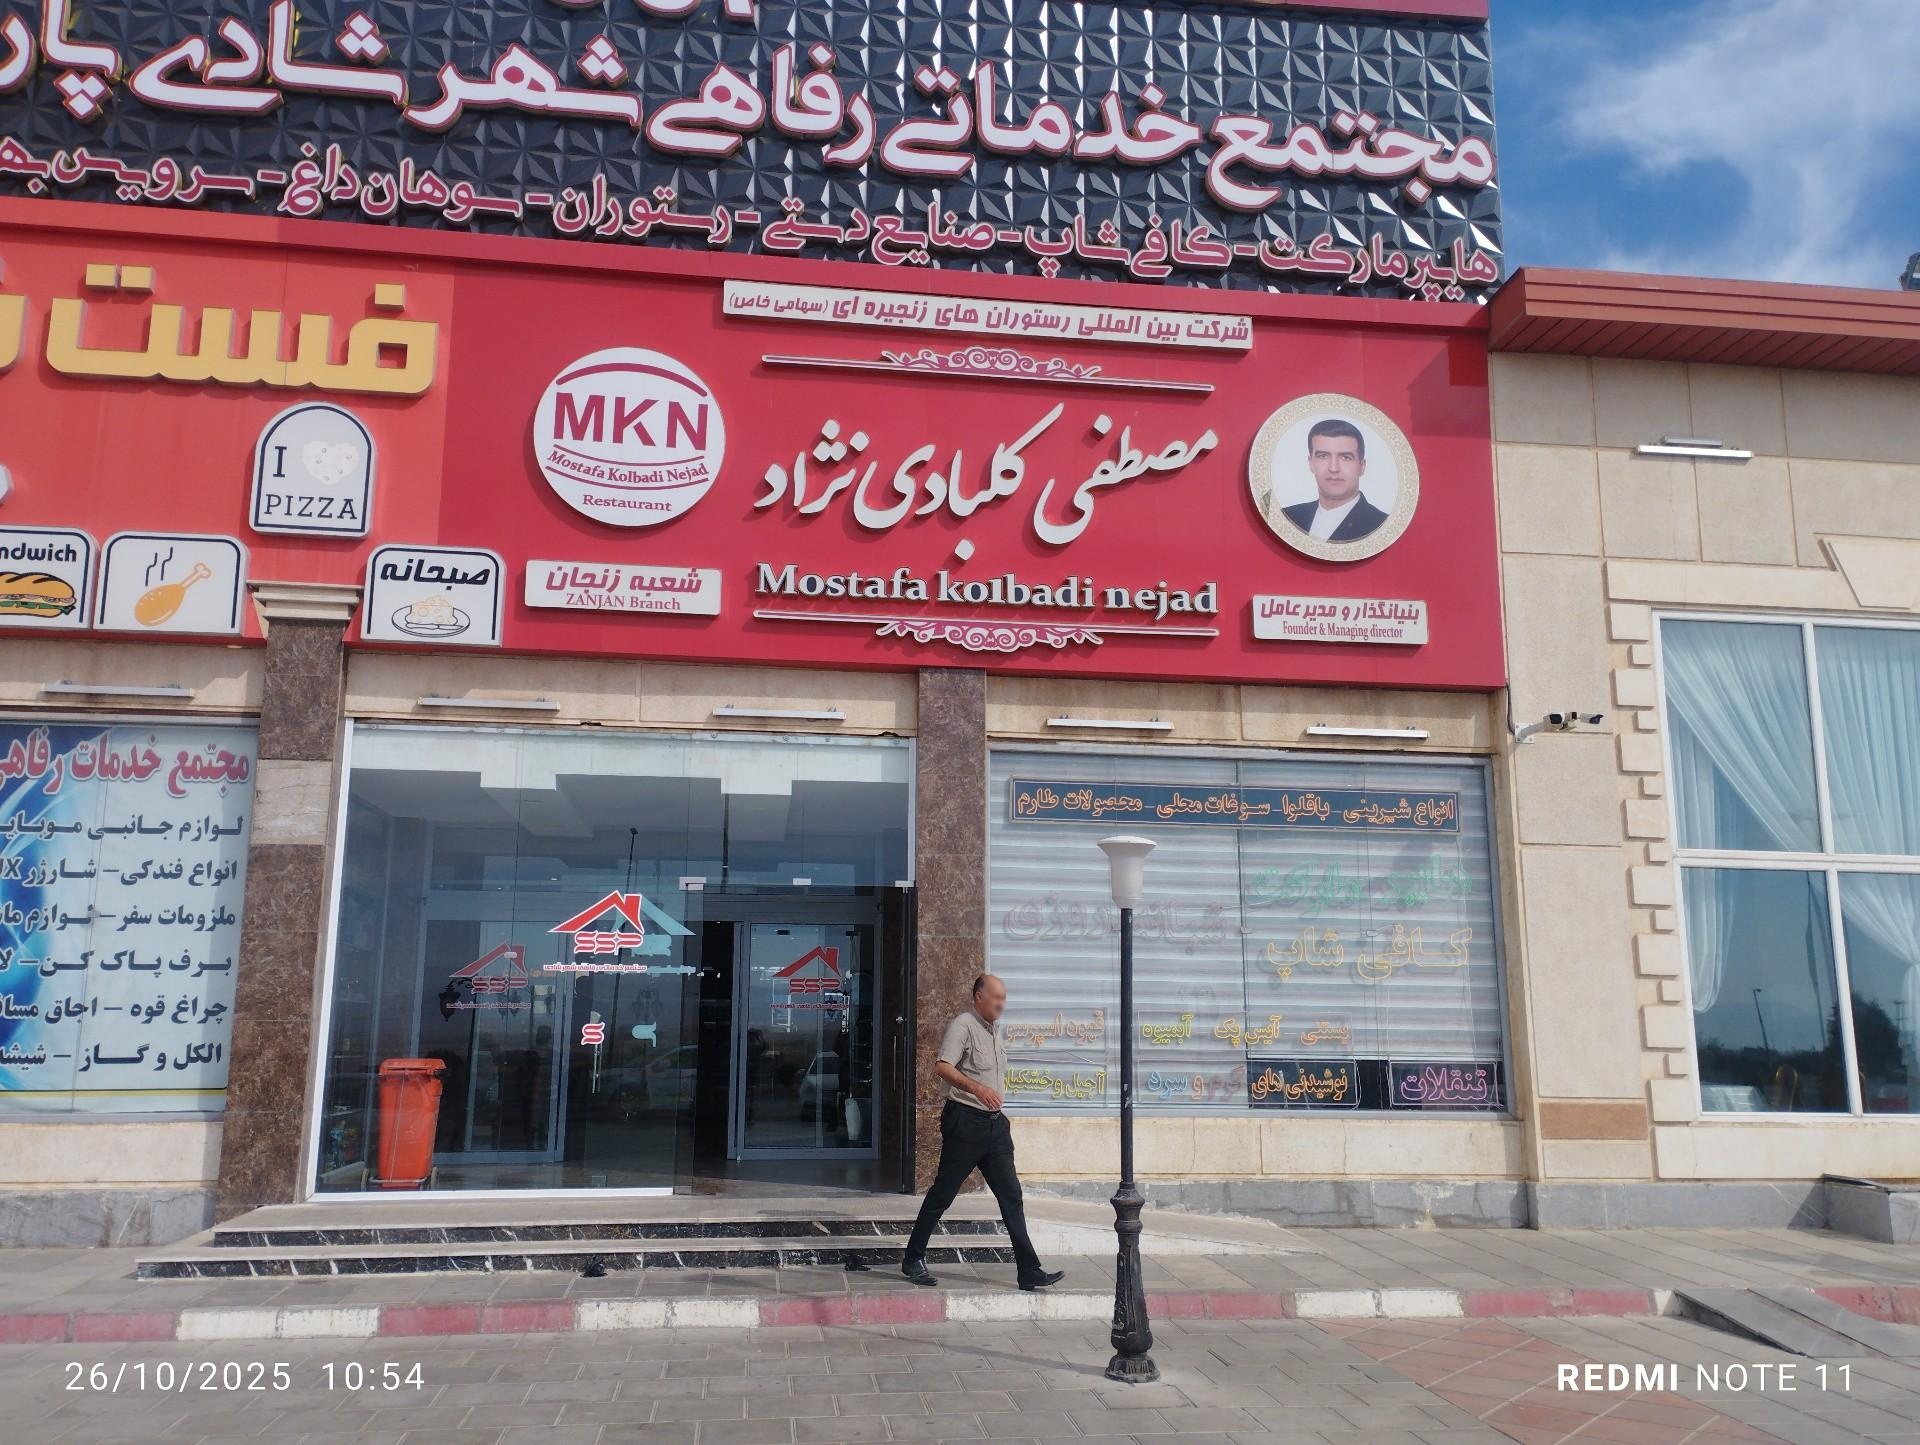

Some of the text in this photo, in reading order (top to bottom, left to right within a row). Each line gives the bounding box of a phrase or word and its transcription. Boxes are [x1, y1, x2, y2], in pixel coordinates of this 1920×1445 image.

[0, 0, 1497, 211] مجتمع خدماتی رفاهی شهر شادی پار
[52, 147, 255, 202] سرویس
[277, 142, 361, 216] داغ
[361, 157, 523, 222] سوهان
[553, 174, 733, 244] رستوران
[762, 197, 870, 251] دستی
[871, 201, 997, 265] صنایع
[1025, 214, 1131, 279] شاپ
[832, 296, 860, 319] ای
[864, 300, 928, 323] زنجیره
[935, 303, 979, 327] های
[985, 305, 1071, 332] رستوران
[47, 263, 440, 396] فست
[1077, 312, 1142, 336] المللی
[1146, 316, 1181, 341] بین
[1187, 316, 1249, 343] شرکت
[553, 391, 709, 451] MKN
[272, 446, 288, 478] I
[547, 450, 709, 483] Mostafa Kolbadi Nejad
[753, 401, 1219, 562] مصطفی کلبادی نژاد
[264, 493, 358, 521] PIZZA
[582, 494, 672, 512] Restaurant
[0, 542, 77, 562] ndwich
[380, 558, 491, 591] صبحانه
[546, 566, 702, 596] شعبه زنجان
[566, 593, 681, 611] ZANJAN Branch
[754, 561, 1220, 623] Mostafa kolbadi nejad
[1260, 599, 1420, 625] بنیانگذار و مدیر عامل
[1282, 621, 1404, 640] Founder & Managing director
[70, 732, 163, 781] خدمات
[167, 742, 251, 797] مجتمع
[1017, 788, 1059, 815] طارم
[1063, 789, 1142, 817] محصولات
[1156, 793, 1203, 818] محلی
[1205, 793, 1270, 820] سوغات
[1282, 794, 1330, 821] باقلوا
[1343, 798, 1411, 824] شیرینی
[1413, 799, 1453, 826] انواع
[0, 811, 244, 841] لوازم جانبی موبای
[22, 858, 97, 887] شارژر
[188, 859, 238, 886] انواع
[117, 904, 152, 931] سفر
[158, 903, 236, 931] ملزومات
[574, 929, 644, 955] SSP
[1267, 922, 1473, 981] کافی شاپ
[39, 950, 94, 977] کن
[100, 950, 162, 978] پاک
[169, 949, 232, 977] برف
[45, 996, 98, 1025] اجاق
[130, 995, 165, 1024] قوه
[171, 995, 229, 1024] چراغ
[78, 1043, 150, 1072] گاز
[153, 1052, 167, 1071] و
[173, 1042, 222, 1071] الکل
[1065, 1070, 1107, 1100] آجیل
[1148, 1071, 1188, 1100] سرد
[1251, 1067, 1283, 1100] های
[1285, 1067, 1348, 1101] نوشیدنی
[1400, 1066, 1488, 1101] تنقلات
